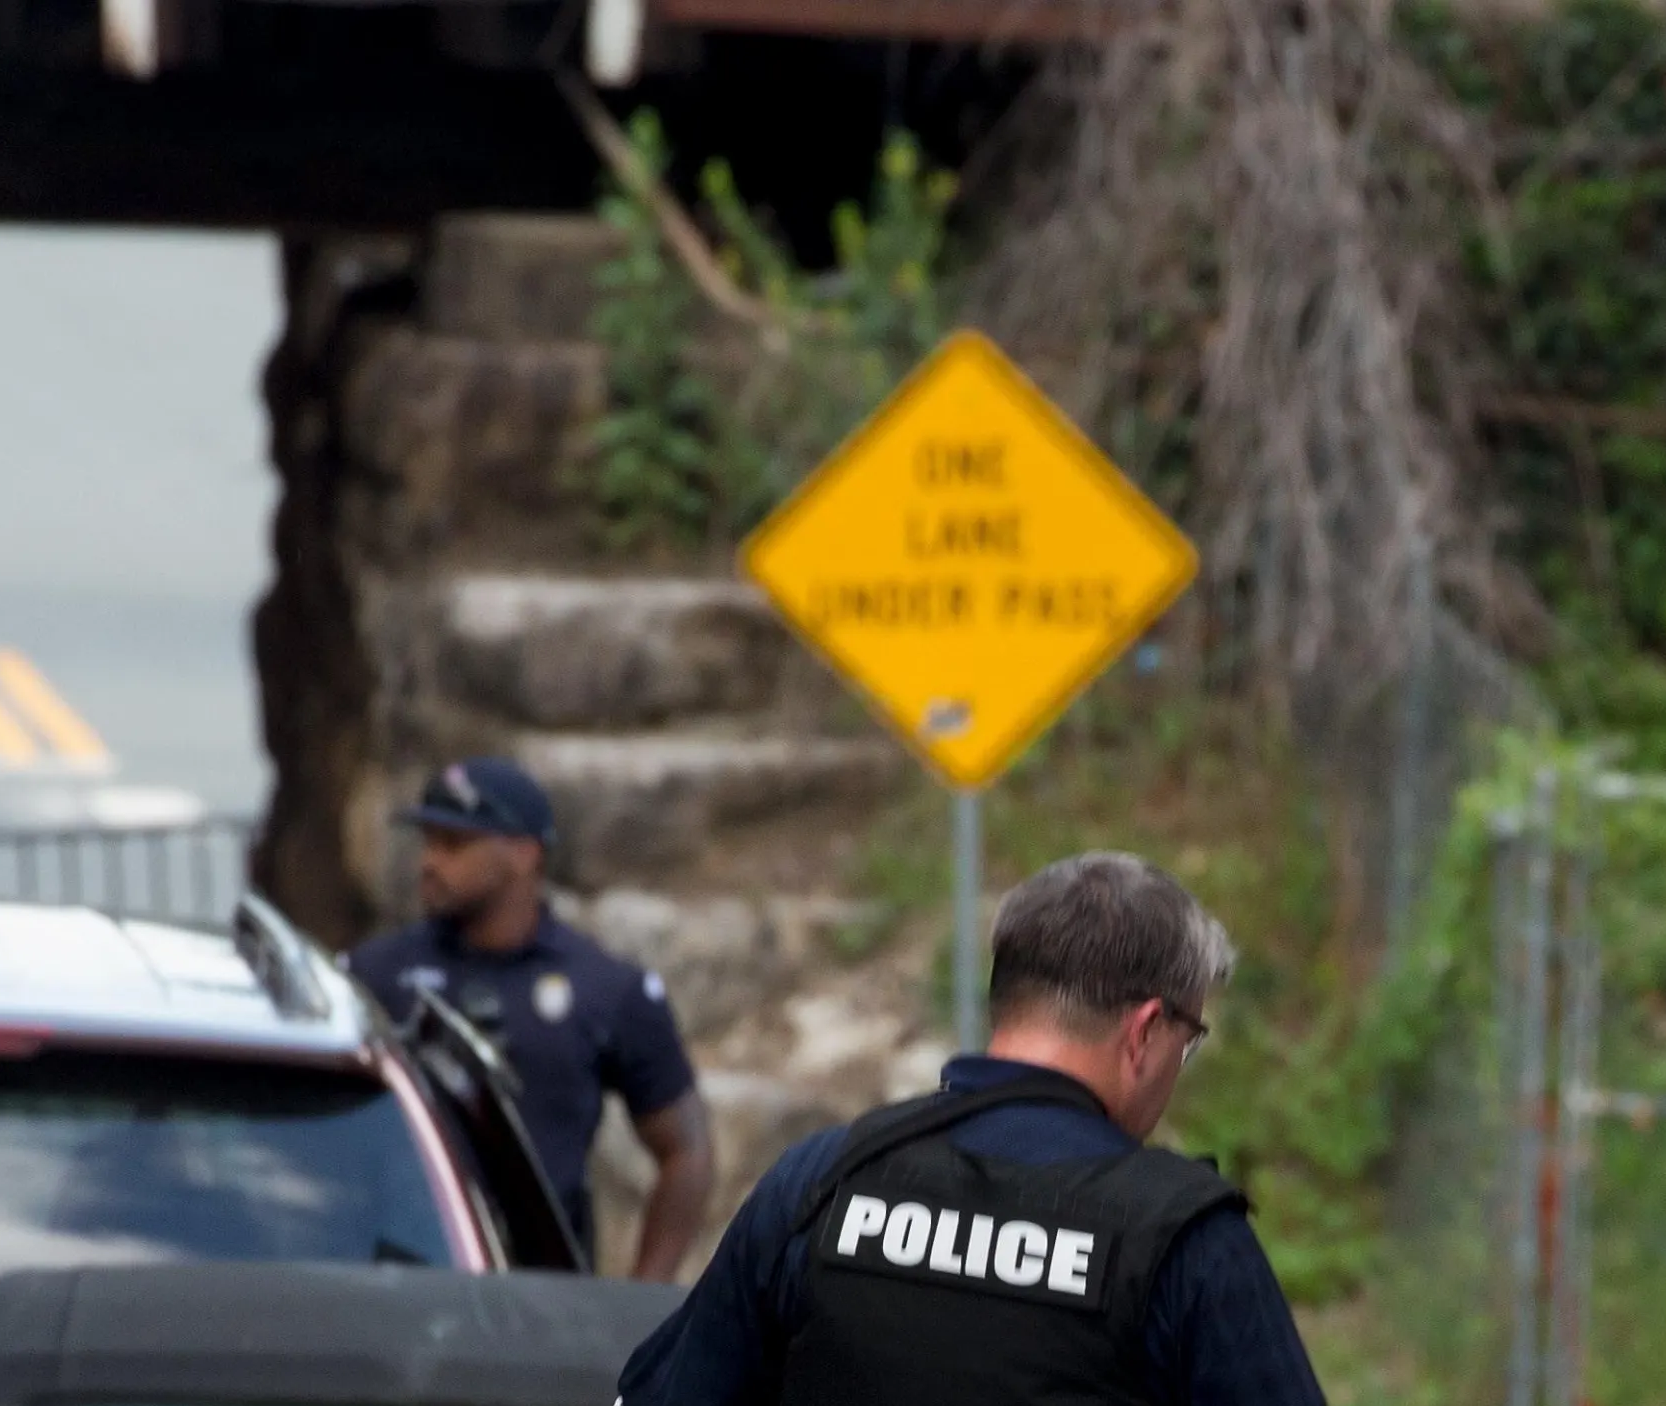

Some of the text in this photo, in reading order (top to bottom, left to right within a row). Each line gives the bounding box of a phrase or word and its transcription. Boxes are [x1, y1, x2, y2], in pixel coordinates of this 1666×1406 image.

[913, 441, 1005, 490] ONE
[905, 508, 1021, 559] LANE
[808, 577, 1119, 633] UNDER PASS
[837, 1194, 1094, 1296] POLICE
